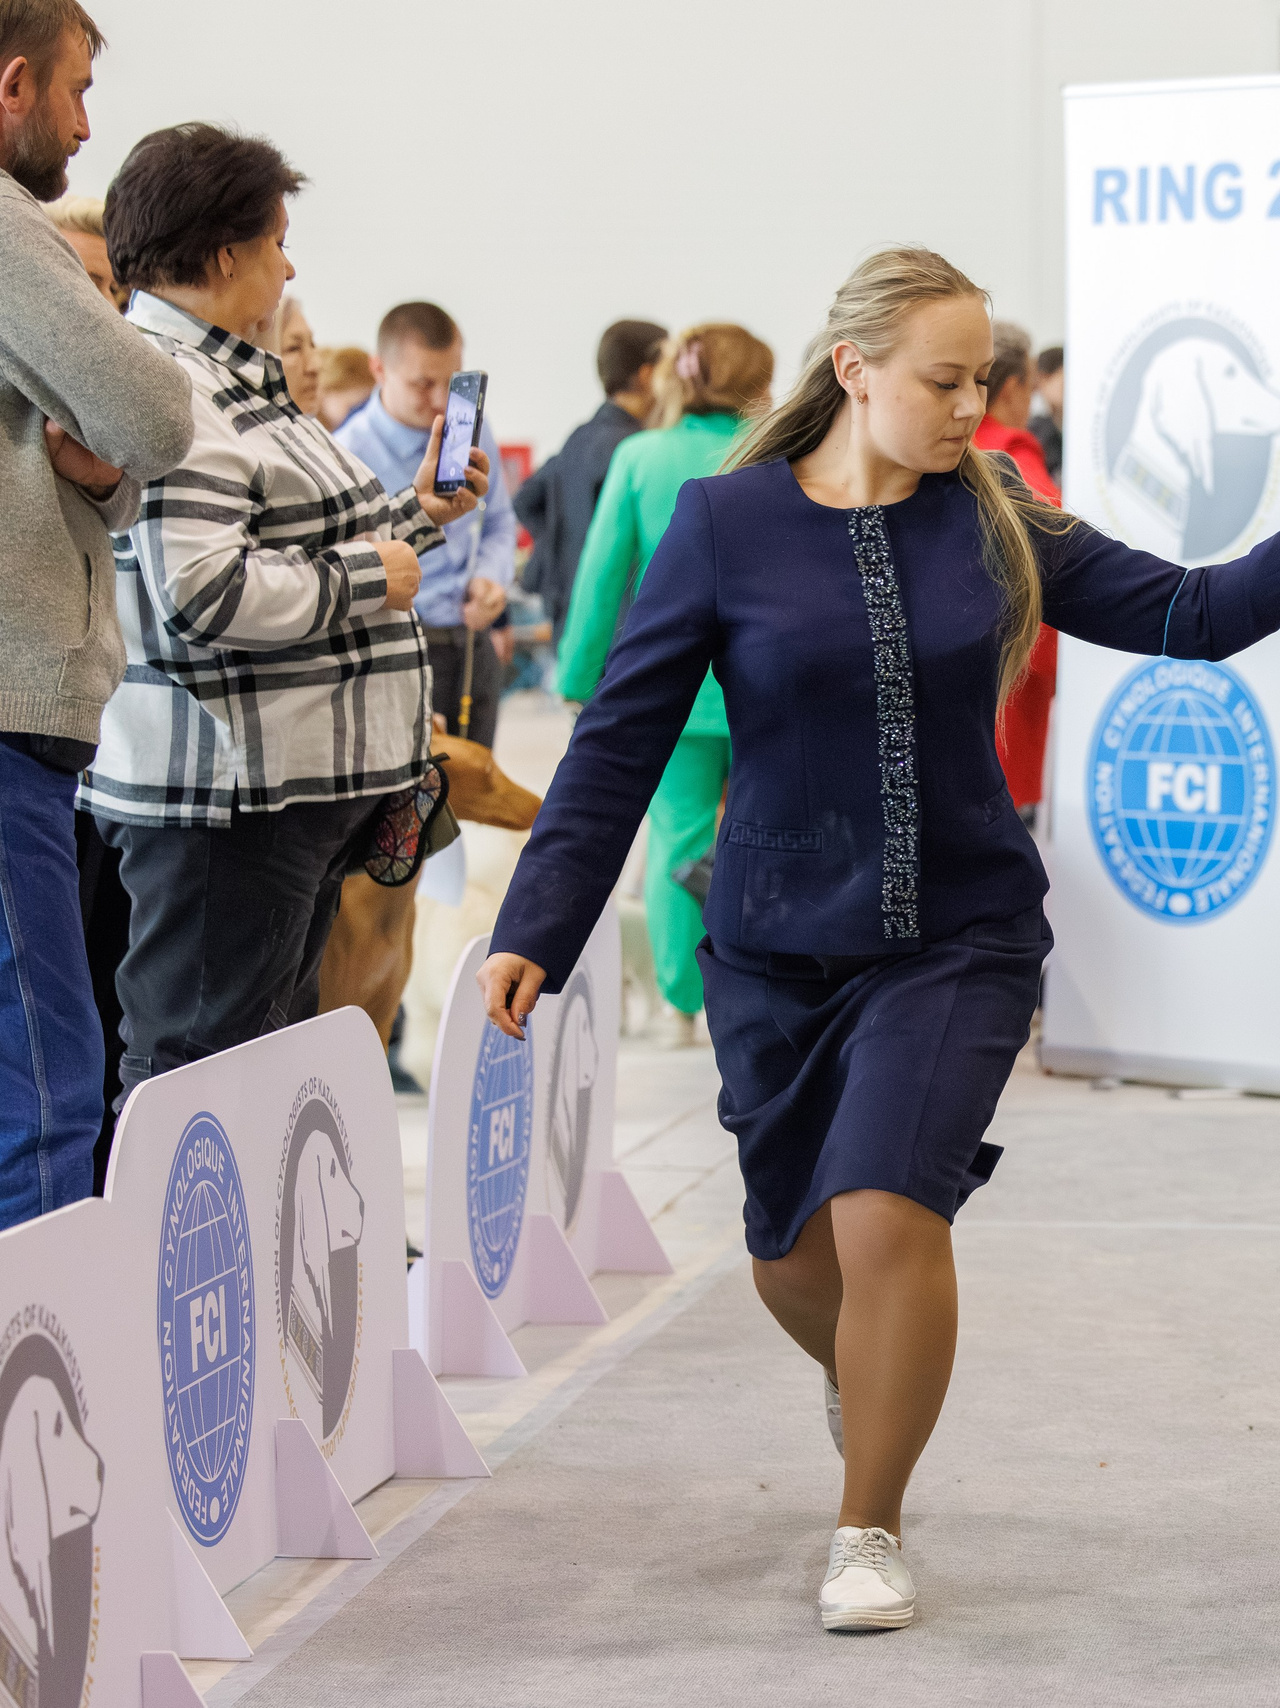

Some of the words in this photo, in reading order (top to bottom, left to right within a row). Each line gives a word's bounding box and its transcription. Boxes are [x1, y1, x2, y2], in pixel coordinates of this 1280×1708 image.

[1092, 162, 1244, 225] RING
[1147, 762, 1222, 813] FCI
[309, 1077, 317, 1096] OF
[318, 1078, 353, 1171] KAZAKHSTAN
[277, 1081, 308, 1200] CYNOLOGISTS
[488, 1103, 516, 1167] FCI
[164, 1137, 226, 1288] CYNOLOGIQUE
[274, 1205, 281, 1240] OF
[189, 1285, 228, 1373] FCI
[163, 1321, 207, 1526] FEDERATION
